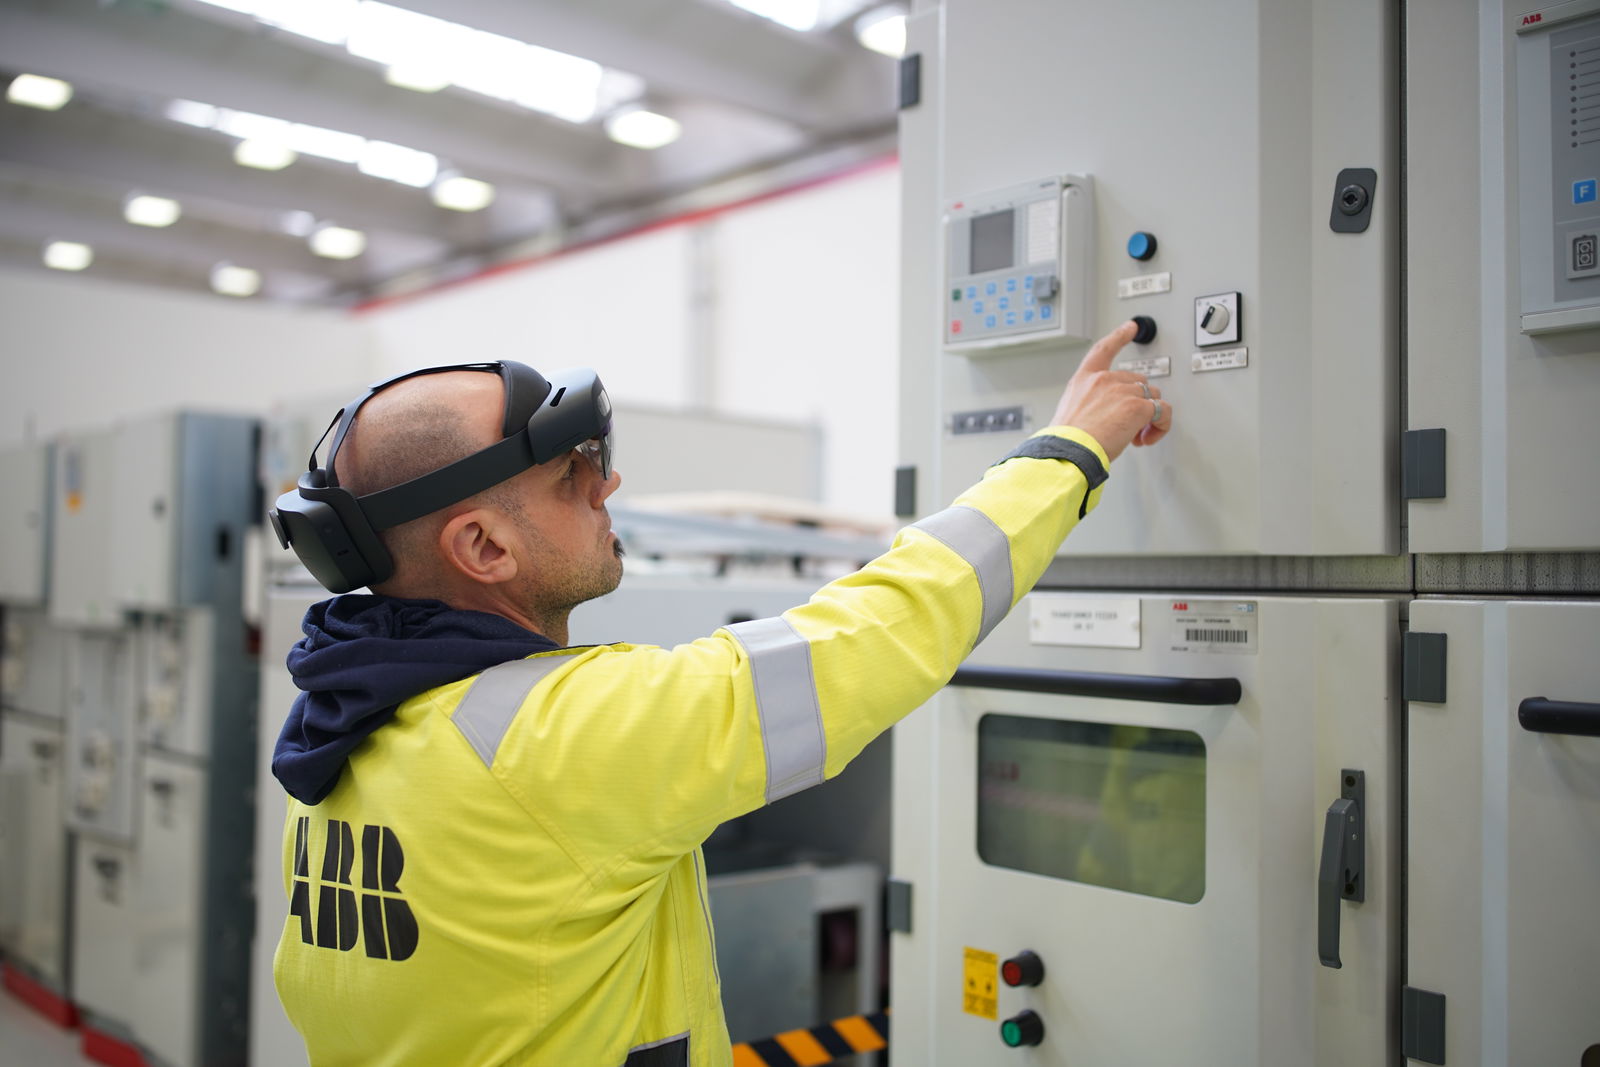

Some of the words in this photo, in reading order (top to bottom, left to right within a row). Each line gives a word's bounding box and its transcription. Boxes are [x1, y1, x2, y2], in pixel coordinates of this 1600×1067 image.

[1522, 13, 1542, 25] ABB
[1580, 185, 1590, 199] F
[1173, 603, 1188, 611] ABB
[290, 816, 419, 962] ABB
